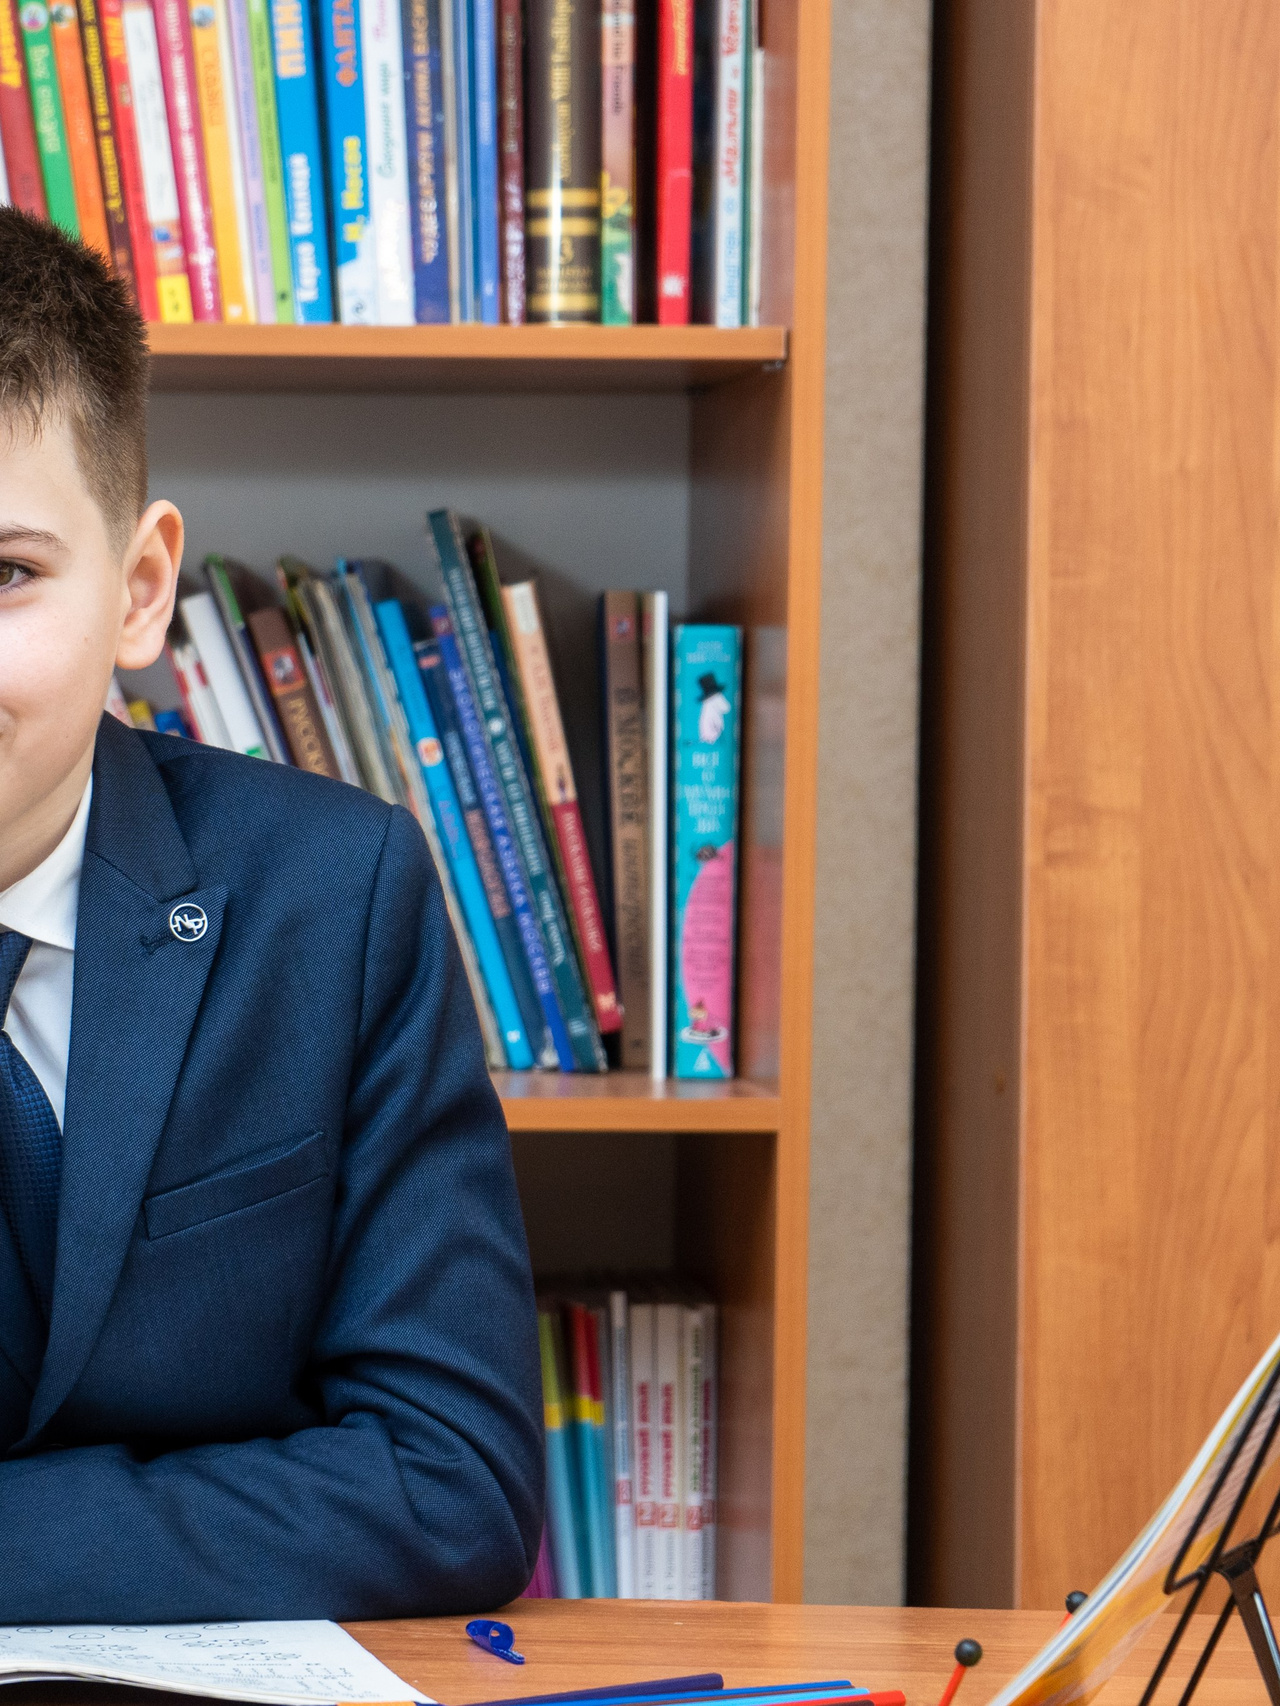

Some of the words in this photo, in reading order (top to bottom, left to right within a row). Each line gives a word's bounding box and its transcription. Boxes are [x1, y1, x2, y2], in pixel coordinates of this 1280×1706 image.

[289, 154, 313, 237] Коллоди
[343, 135, 364, 210] Носов
[296, 242, 318, 302] Карло
[446, 667, 505, 830] ЭКОЛОГИЧЕСКАЯ
[494, 831, 528, 908] АЗБУКА
[517, 910, 554, 994] МОСКВЫ
